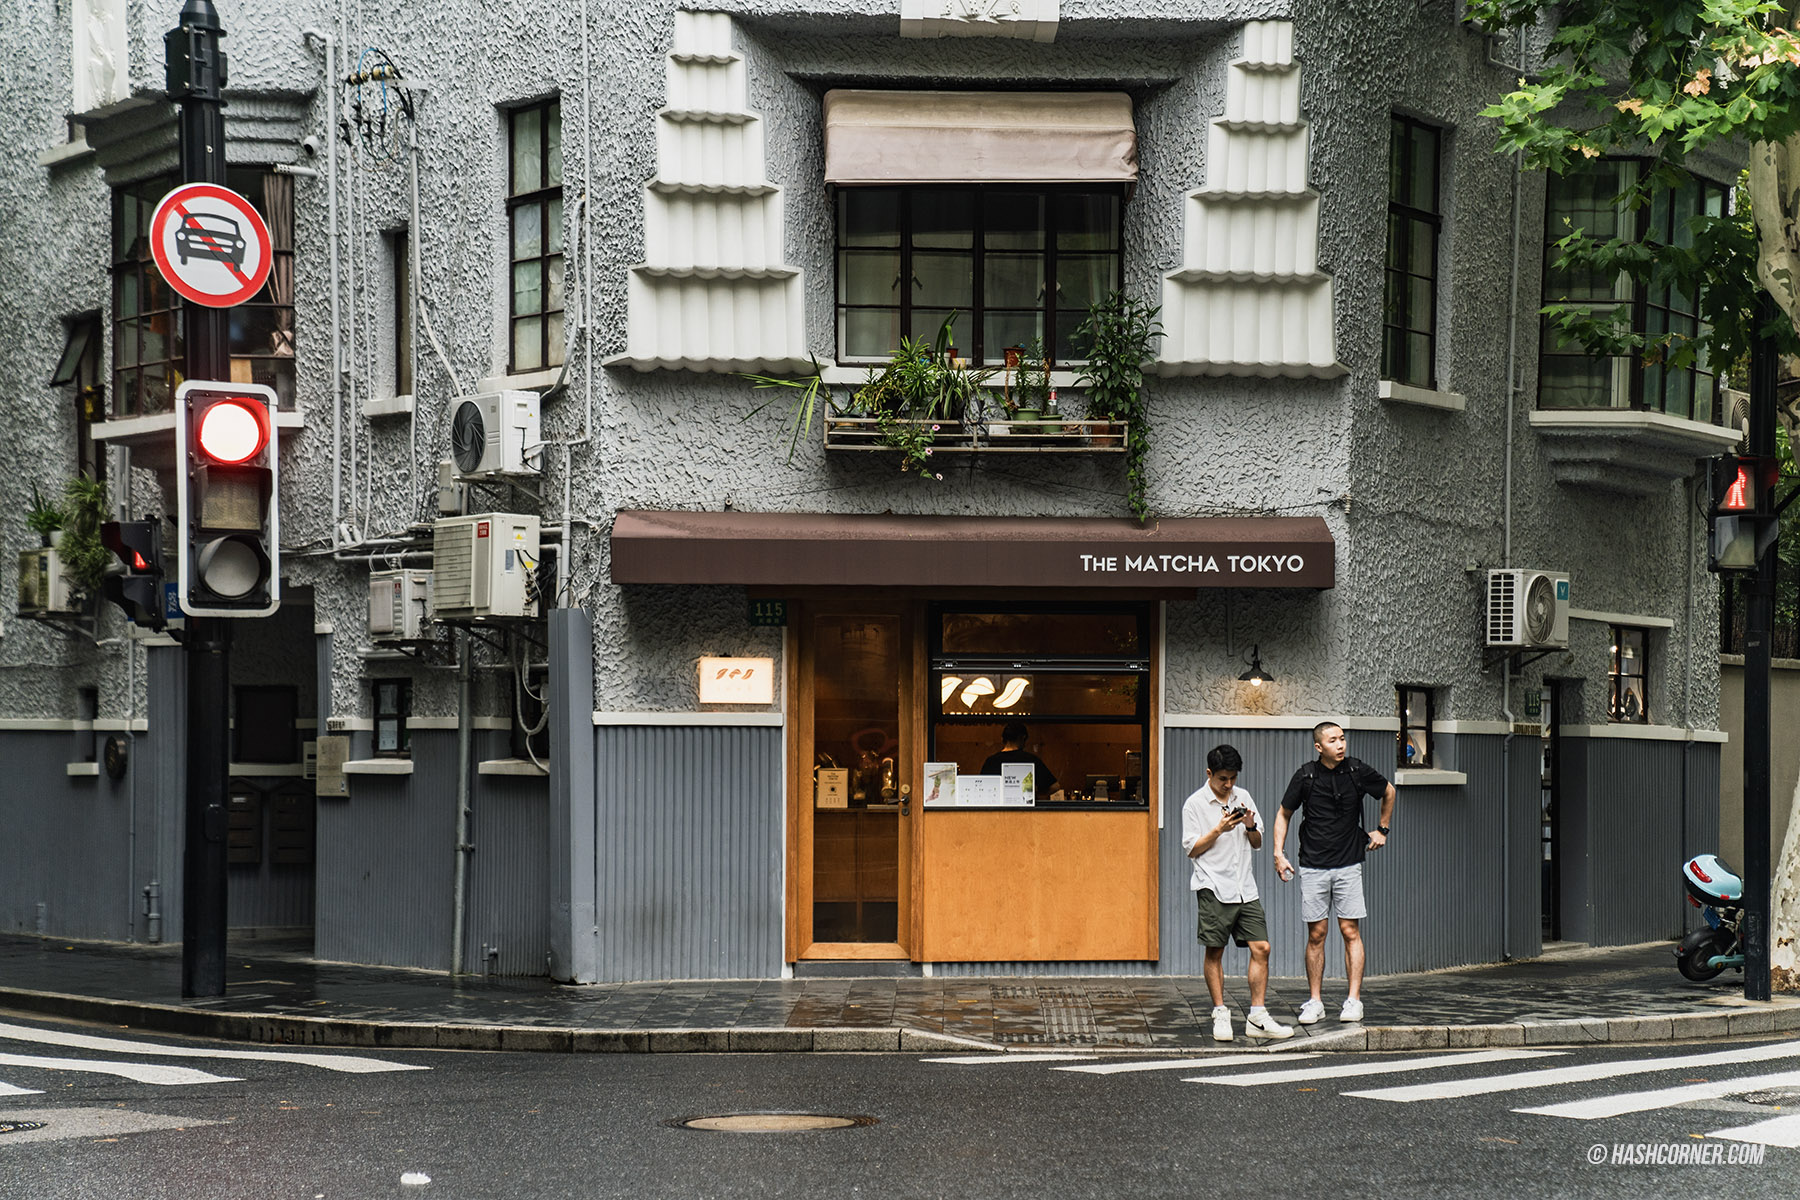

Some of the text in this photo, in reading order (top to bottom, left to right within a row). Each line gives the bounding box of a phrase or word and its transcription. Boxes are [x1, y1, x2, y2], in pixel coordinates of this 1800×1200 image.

[1125, 554, 1220, 573] MATCHA
[1227, 554, 1305, 573] TOKYO
[755, 602, 783, 617] 115
[1528, 694, 1540, 706] 115
